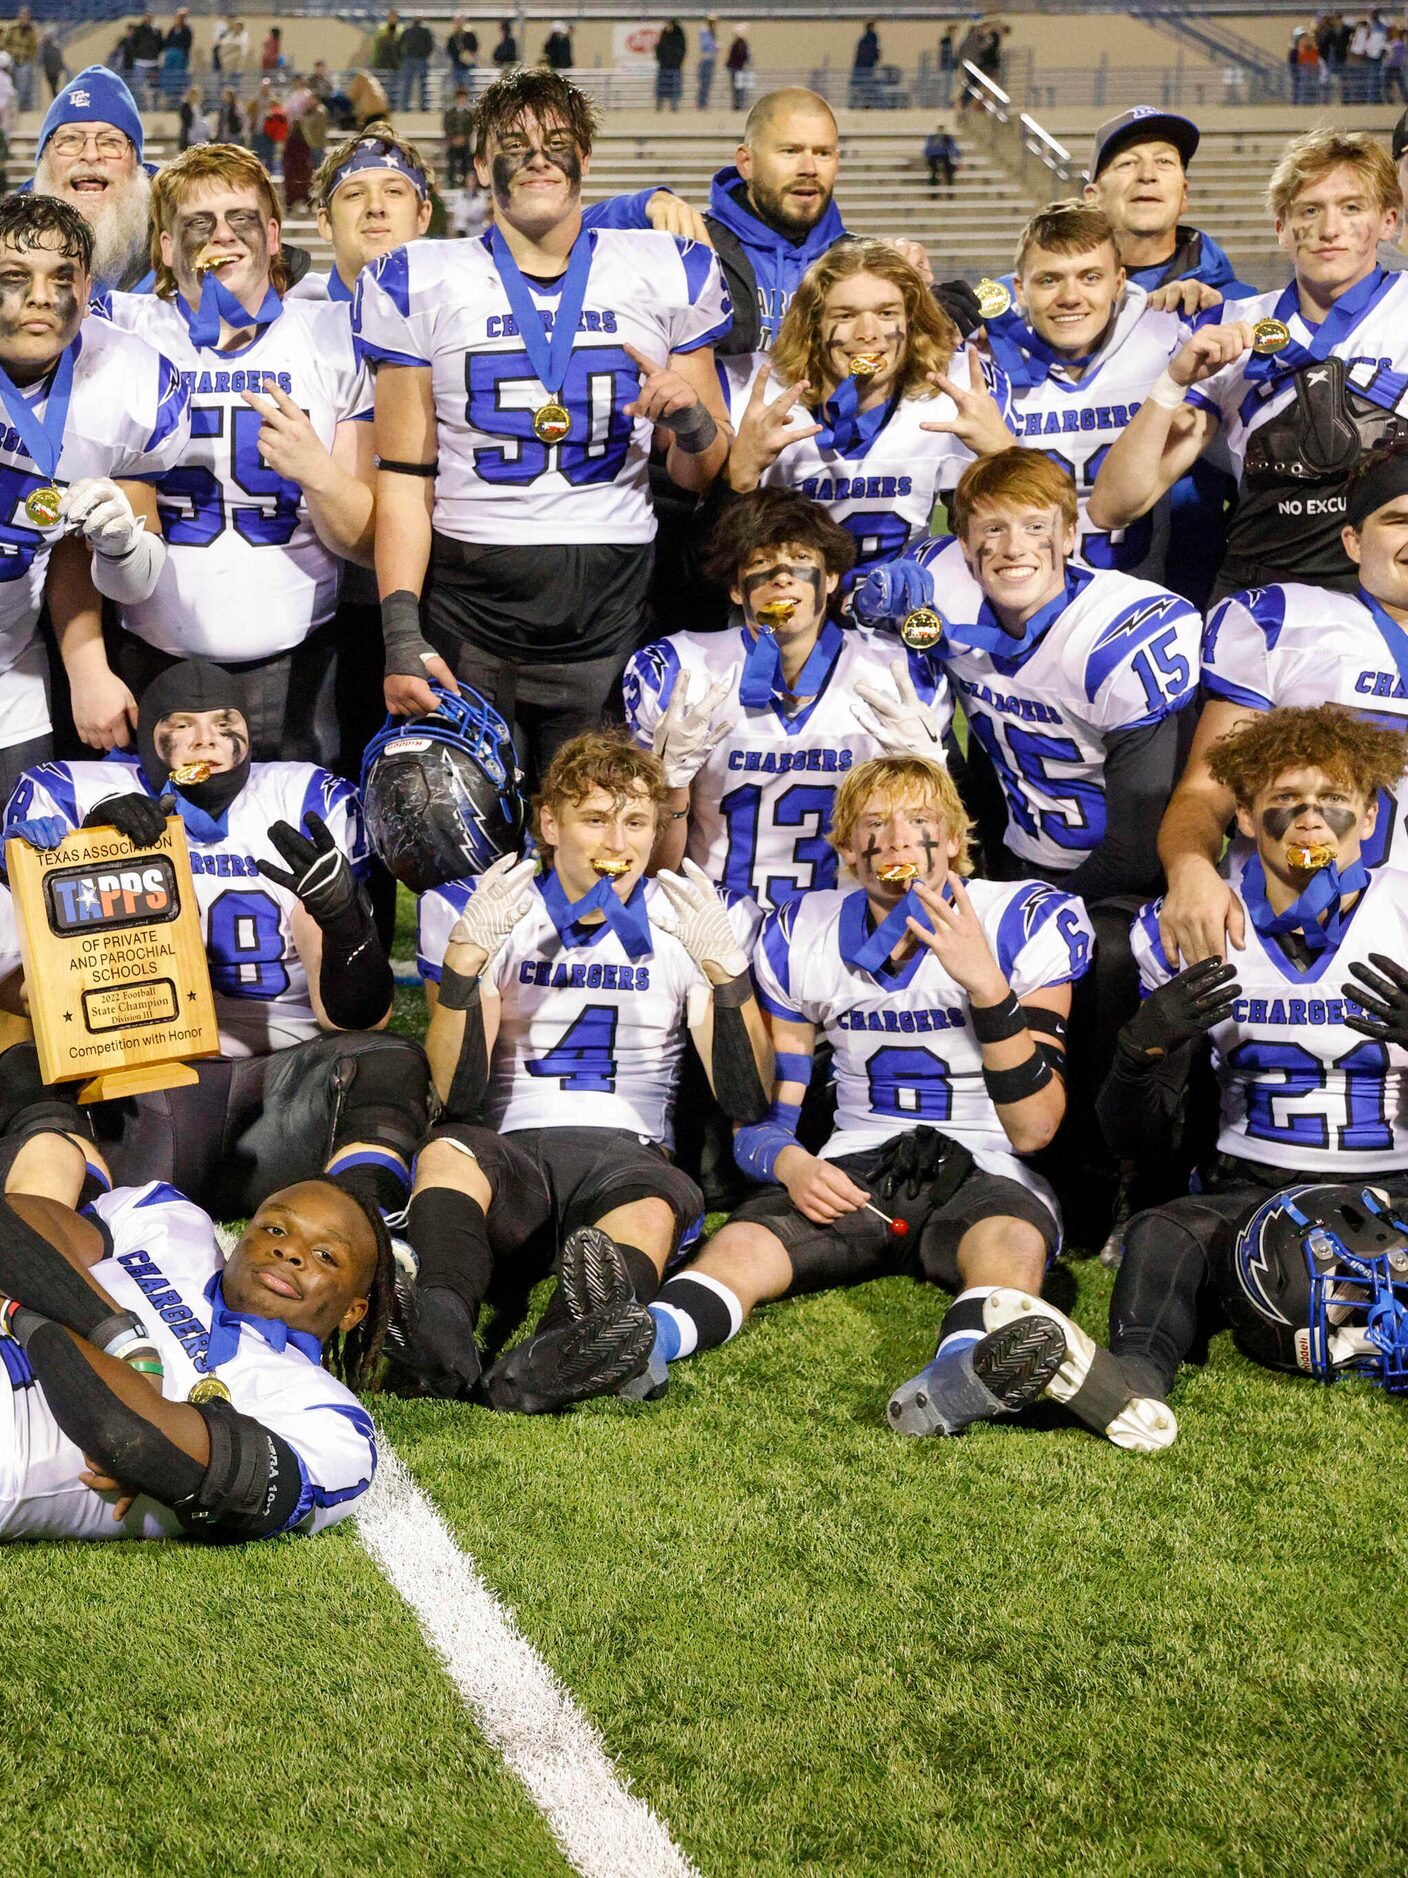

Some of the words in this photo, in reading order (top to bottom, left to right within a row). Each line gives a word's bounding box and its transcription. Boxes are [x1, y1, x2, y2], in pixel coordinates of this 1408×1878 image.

[464, 343, 636, 487] 50
[1278, 500, 1303, 515] NO
[1131, 627, 1191, 711] 15
[728, 748, 853, 773] CHARGERS
[969, 710, 1108, 851] 15
[36, 849, 80, 867] TEXAS
[718, 782, 841, 910] 13
[55, 868, 168, 923] TAPPS
[82, 939, 100, 953] OF
[103, 930, 158, 949] PRIVATE
[1055, 908, 1090, 974] 6
[69, 956, 97, 971] AND
[100, 944, 176, 966] PAROCHIAL
[92, 961, 158, 983] SCHOOLS
[520, 960, 650, 991] CHARGERS
[91, 1005, 116, 1017] State
[118, 997, 169, 1013] Champion
[101, 992, 120, 1004] 2022
[123, 987, 156, 1000] Football
[111, 1013, 142, 1025] Division
[142, 1010, 153, 1019] III
[836, 1006, 967, 1033] CHARGERS
[69, 1038, 140, 1059] Competition
[142, 1032, 166, 1046] with
[168, 1027, 203, 1043] Honor
[523, 1003, 619, 1094] 4
[1227, 1038, 1395, 1151] 21
